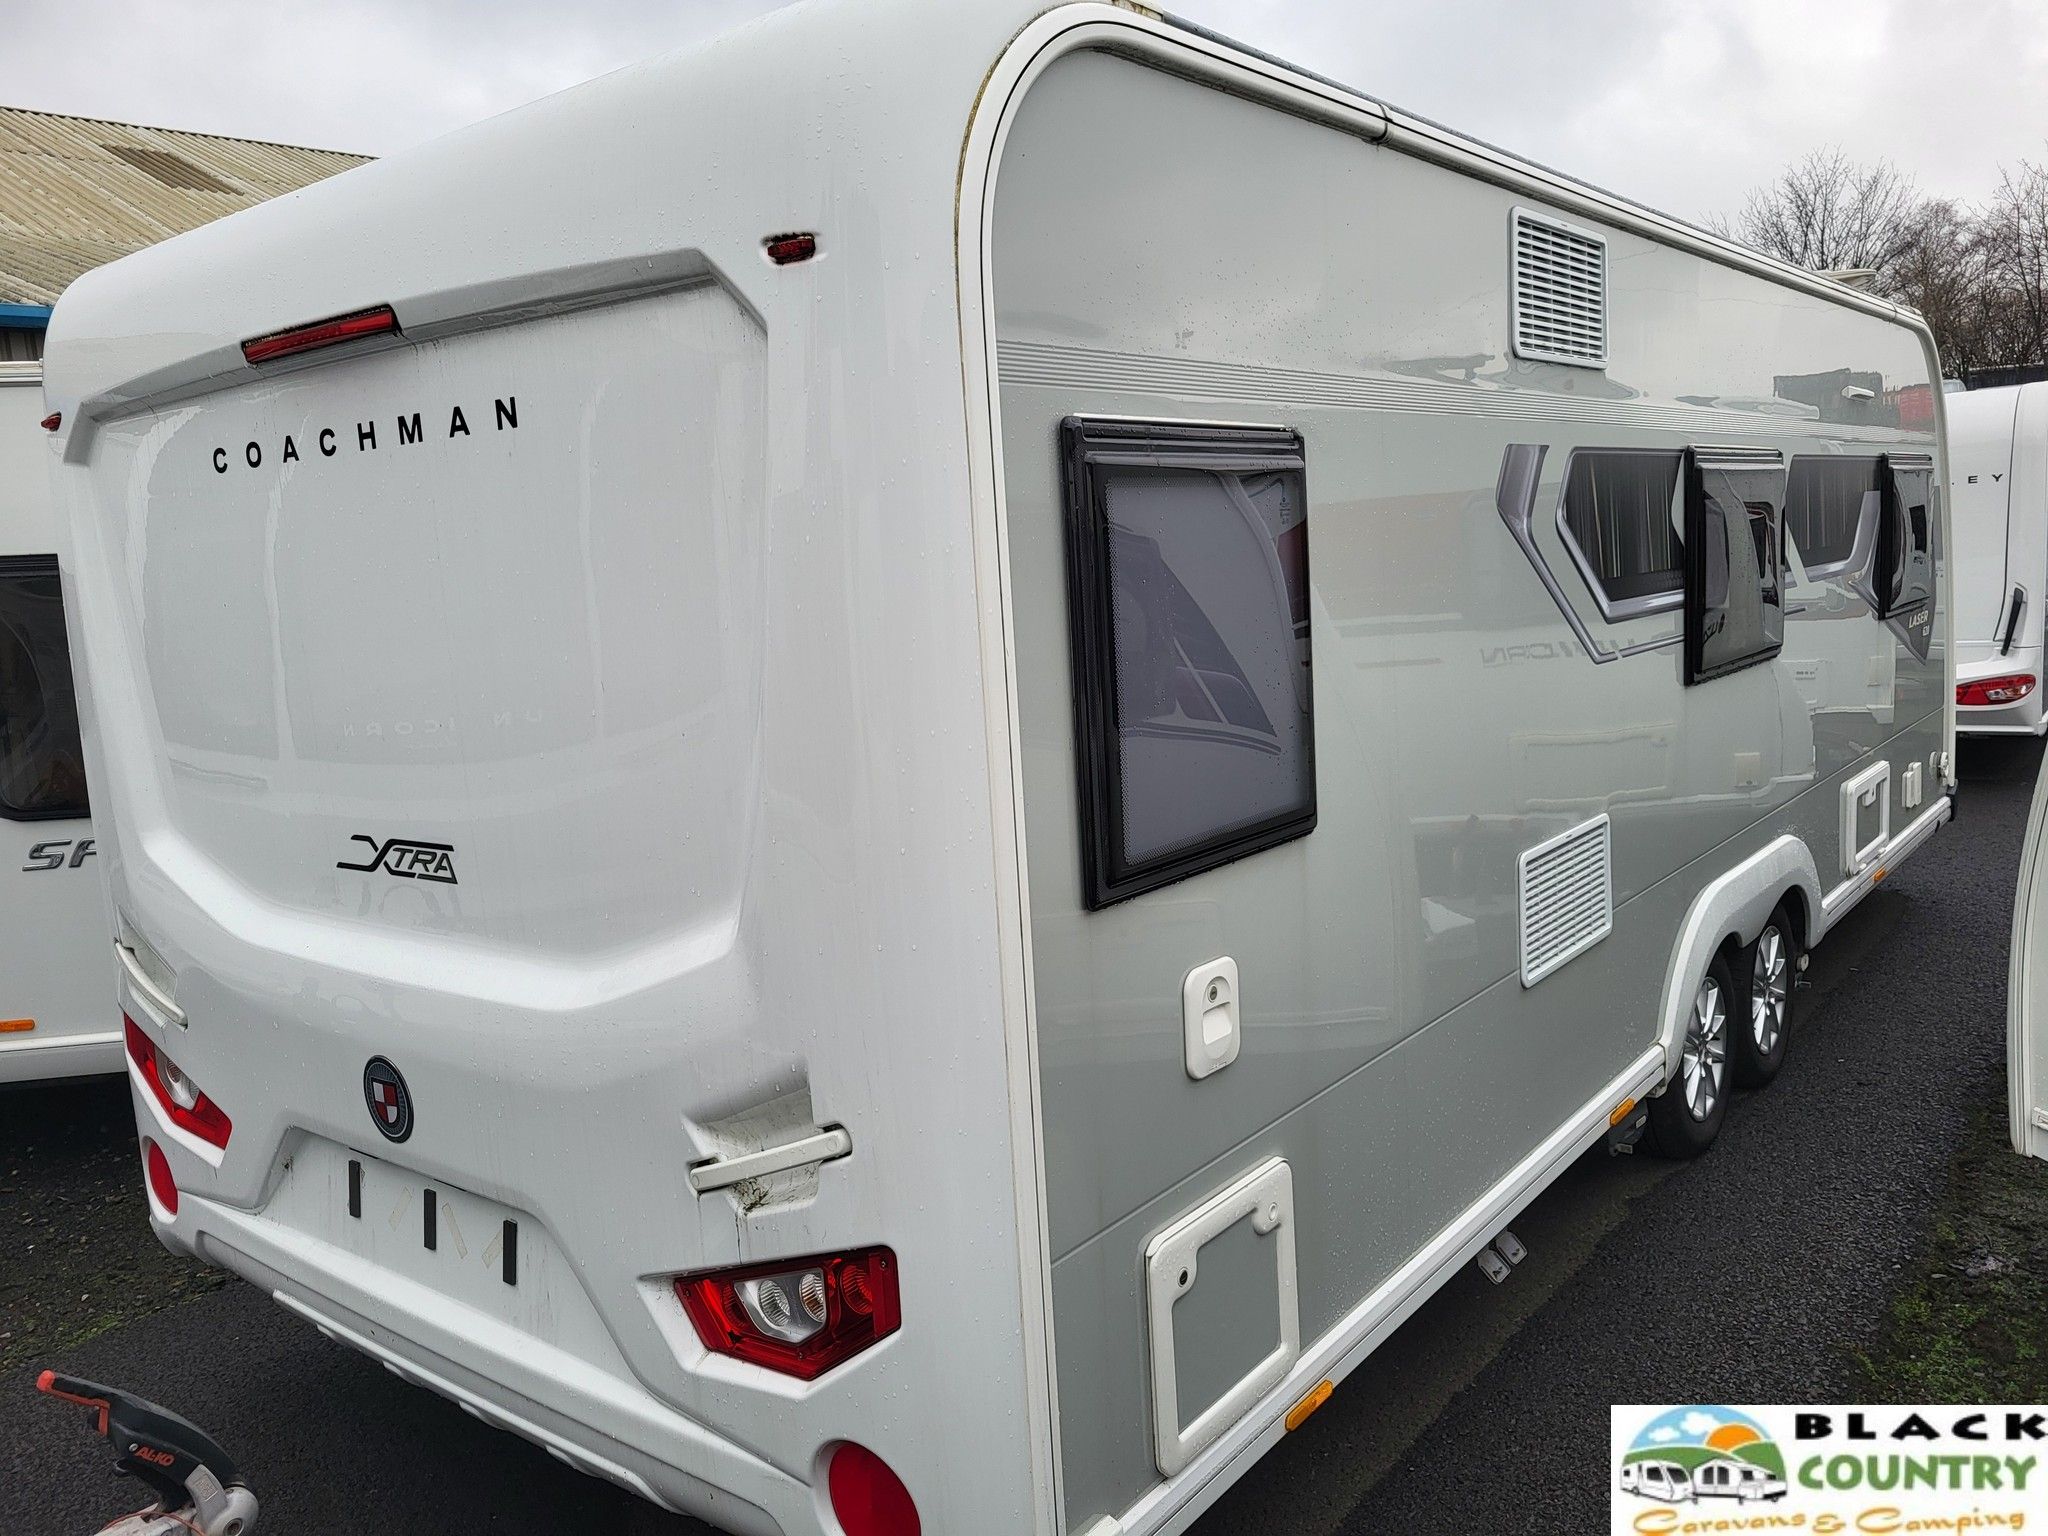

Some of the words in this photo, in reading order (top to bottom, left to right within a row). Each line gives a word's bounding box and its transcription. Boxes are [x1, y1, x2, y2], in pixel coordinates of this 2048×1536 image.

[213, 396, 518, 474] COACHMAN
[1952, 473, 2003, 485] EY
[1908, 610, 1929, 629] LASER
[336, 834, 458, 884] XTRA
